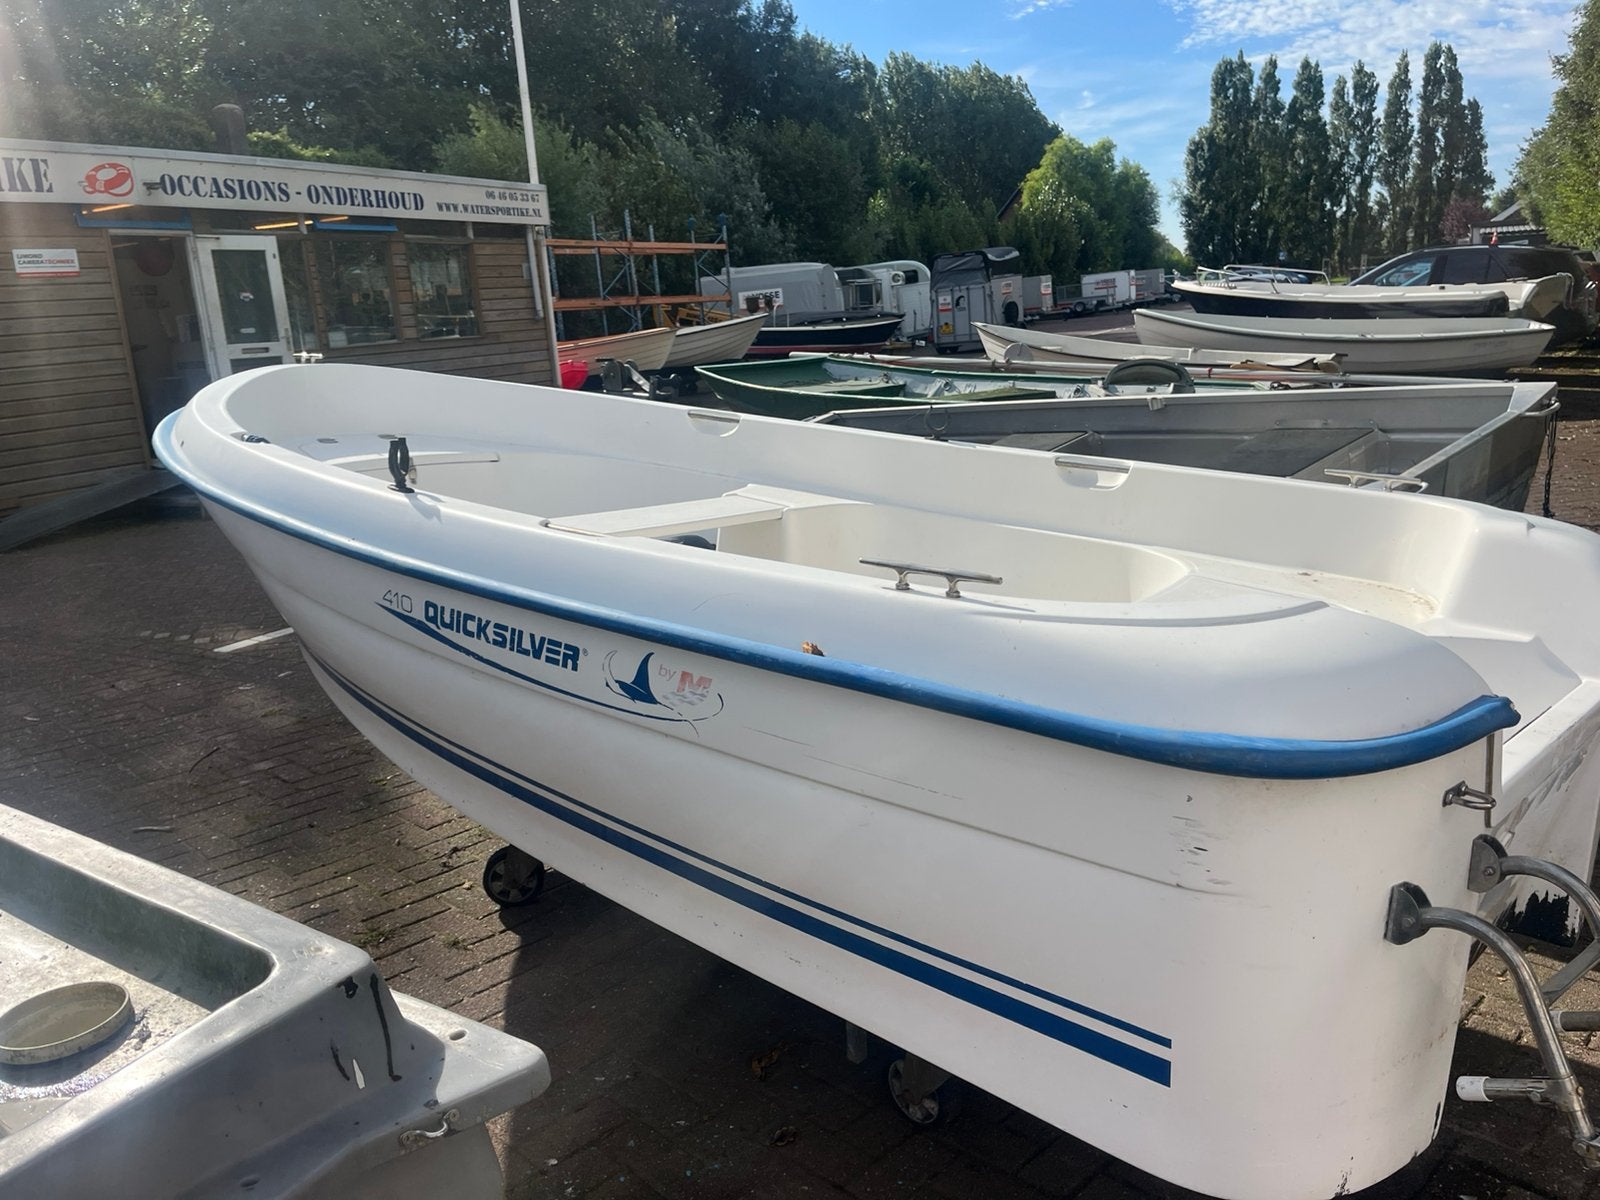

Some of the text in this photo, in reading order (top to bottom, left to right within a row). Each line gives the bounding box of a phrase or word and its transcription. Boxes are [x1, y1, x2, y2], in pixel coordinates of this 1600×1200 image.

[0, 157, 53, 192] KE
[160, 173, 290, 202] OCCASIONS
[307, 184, 424, 211] ONDERHOUD
[485, 190, 496, 200] 06
[508, 192, 518, 202] 05
[436, 202, 542, 218] WWW.WATERSPORTIKE.NL
[382, 589, 581, 672] 410 QUICKSILVER
[658, 664, 677, 682] by
